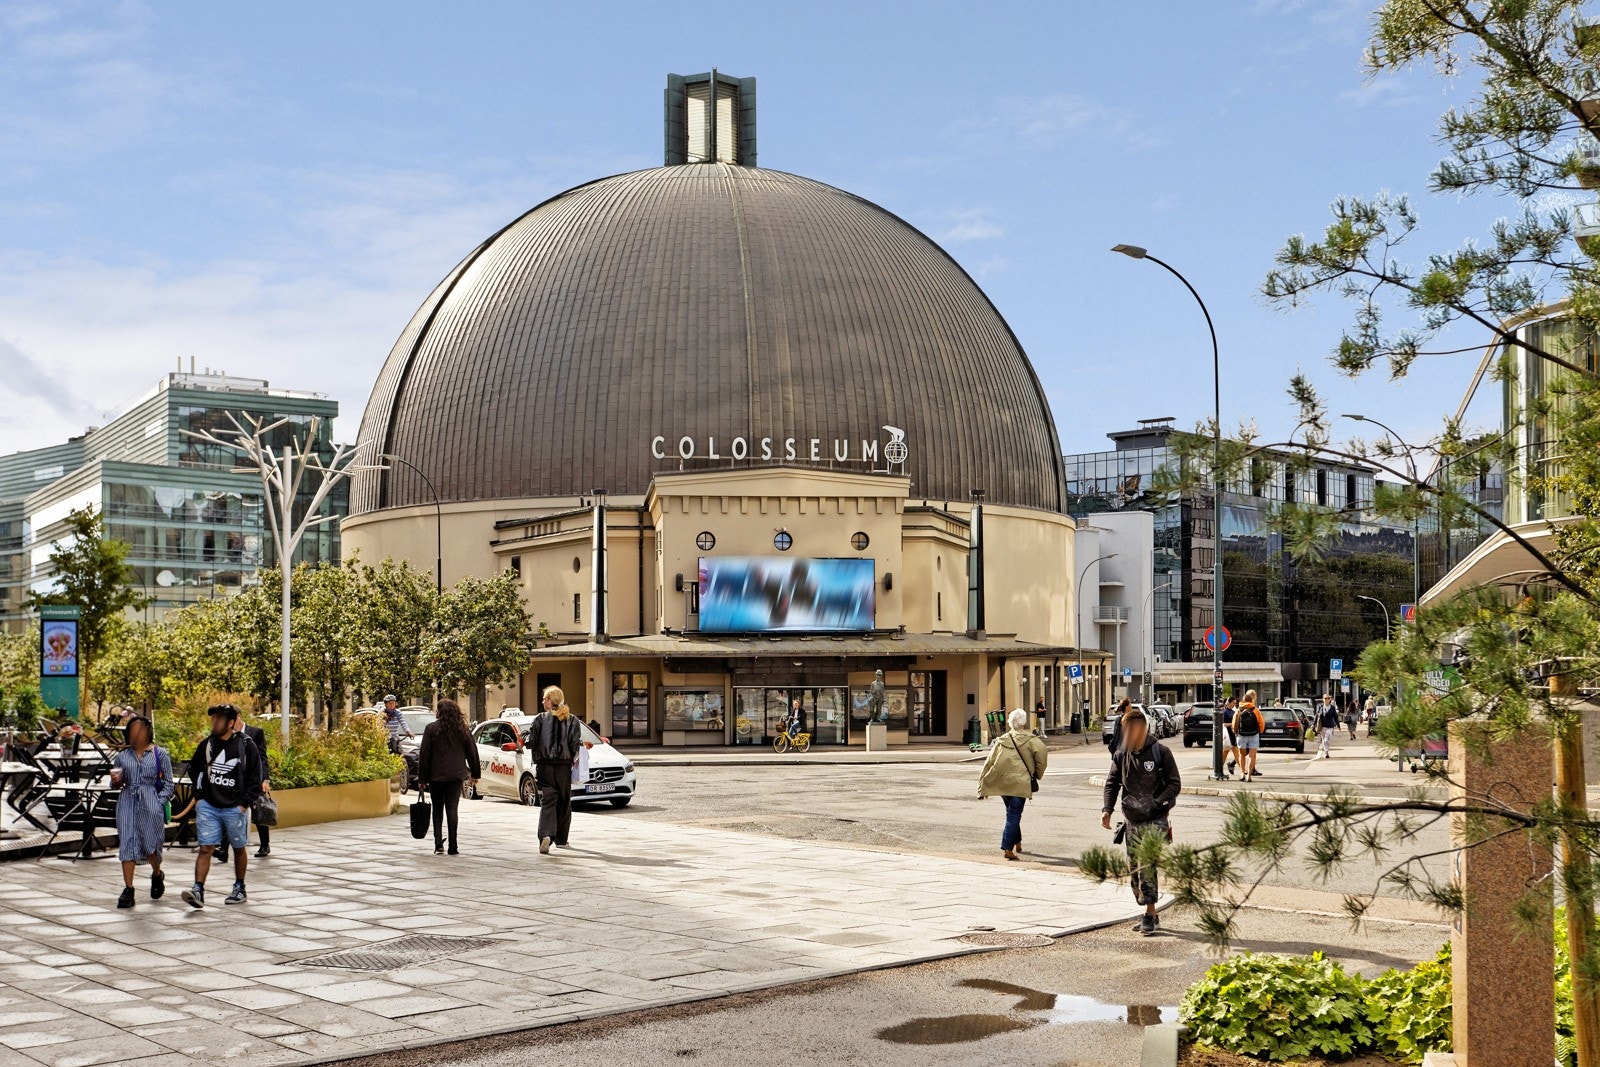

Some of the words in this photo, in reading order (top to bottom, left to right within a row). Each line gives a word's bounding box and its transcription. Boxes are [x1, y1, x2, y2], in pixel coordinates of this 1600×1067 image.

[651, 435, 878, 462] COLOSSEUM
[1333, 660, 1340, 669] P
[1071, 666, 1078, 676] P
[491, 762, 514, 776] OsloTaxi
